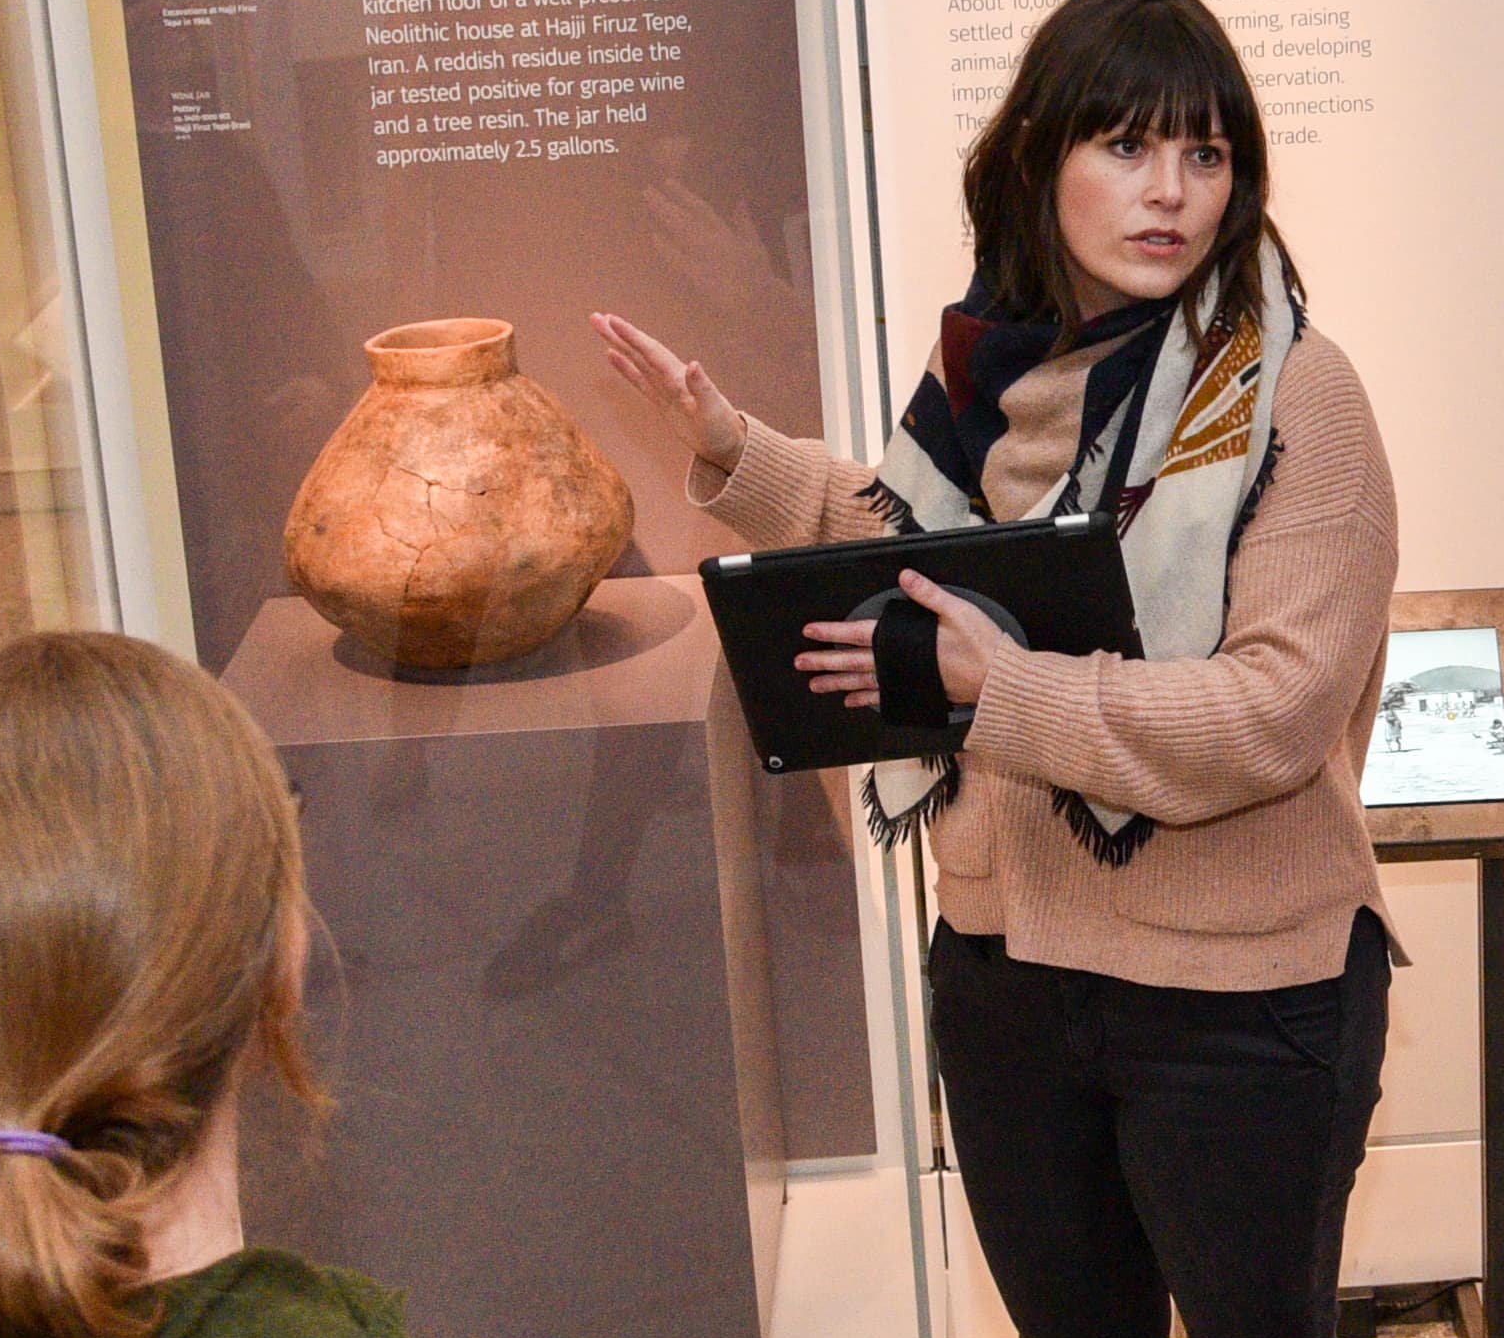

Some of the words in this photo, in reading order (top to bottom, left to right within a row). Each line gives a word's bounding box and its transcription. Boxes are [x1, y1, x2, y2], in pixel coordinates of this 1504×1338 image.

[366, 22, 449, 44] Neolithic
[455, 21, 513, 39] house
[520, 19, 539, 37] at
[545, 15, 585, 38] Hajji
[593, 14, 637, 32] Firuz
[645, 13, 691, 34] Tepe,
[949, 21, 1012, 42] settled
[1290, 8, 1350, 29] raising
[368, 57, 408, 74] Iran.
[415, 54, 428, 72] A
[434, 50, 504, 71] reddish
[512, 47, 580, 67] residue
[587, 43, 642, 63] inside
[649, 41, 680, 60] the
[1272, 36, 1371, 58] developing
[371, 86, 394, 108] jar
[400, 82, 460, 103] tested
[468, 79, 540, 104] positive
[546, 76, 574, 95] for
[580, 78, 633, 98] grape
[639, 71, 684, 91] wine
[1263, 95, 1374, 116] connections
[377, 140, 509, 167] approximately
[515, 139, 541, 157] 2.5
[547, 136, 618, 160] gallons.
[1270, 126, 1322, 146] trade.
